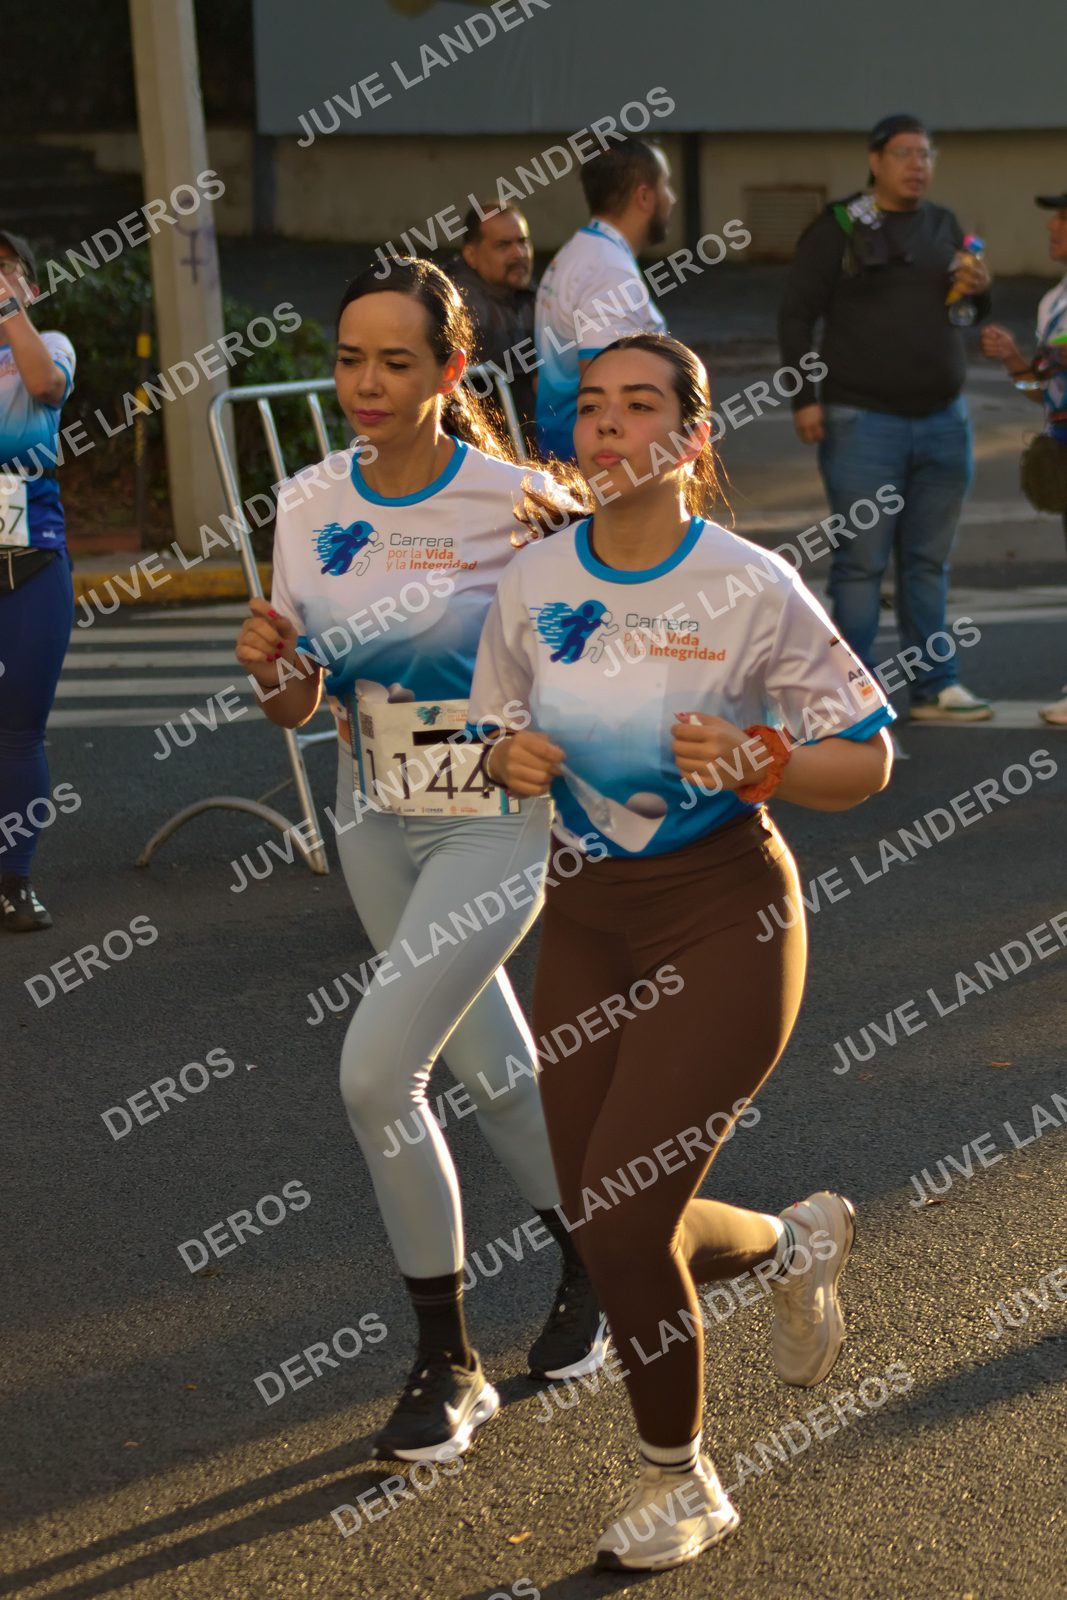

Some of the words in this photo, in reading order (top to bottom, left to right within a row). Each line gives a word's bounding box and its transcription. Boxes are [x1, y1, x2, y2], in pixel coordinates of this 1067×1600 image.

[390, 533, 454, 548] Carrera
[387, 549, 407, 560] por
[410, 548, 422, 559] la
[426, 548, 454, 560] Vida
[386, 562, 393, 572] y
[396, 560, 406, 570] la
[625, 613, 698, 632] Carrera
[666, 630, 700, 646] Vida
[649, 644, 726, 662] Integridad
[366, 748, 495, 800] 1144
